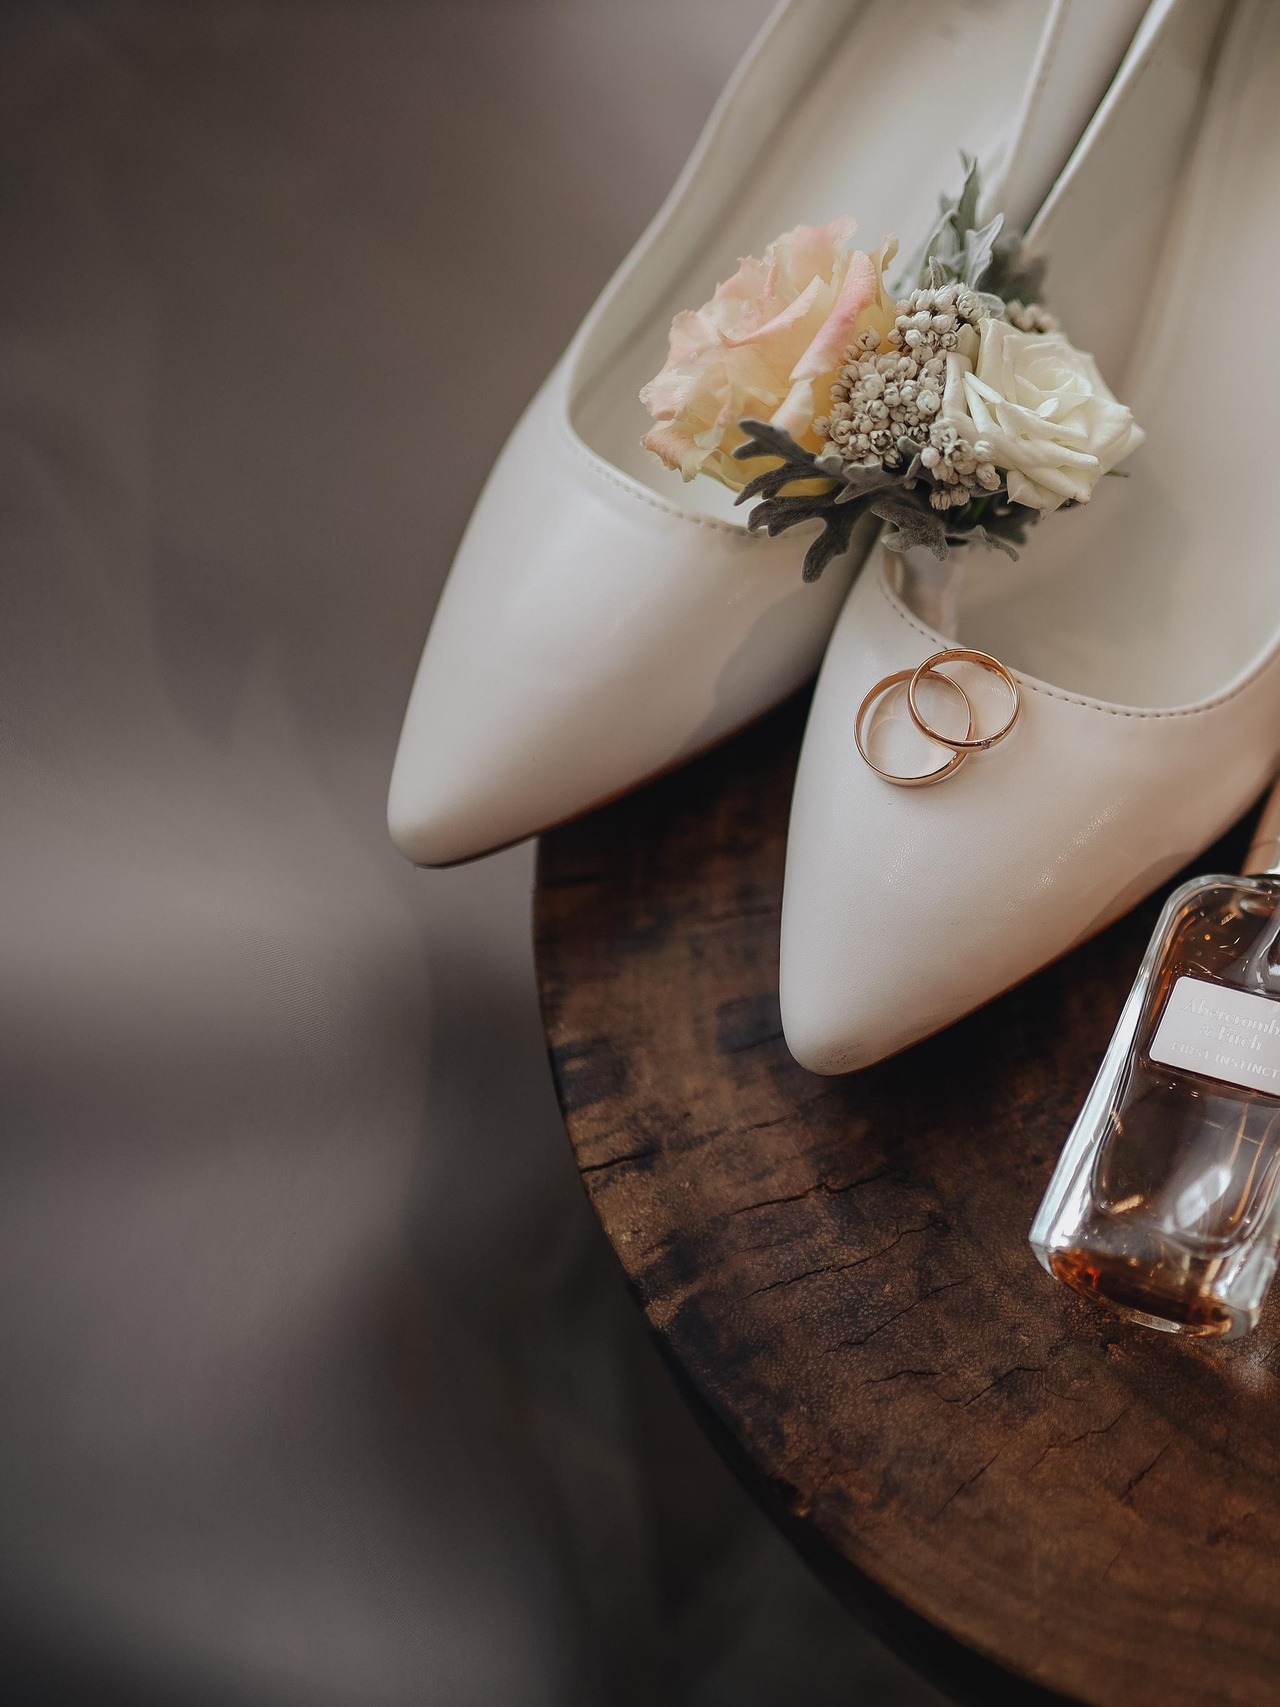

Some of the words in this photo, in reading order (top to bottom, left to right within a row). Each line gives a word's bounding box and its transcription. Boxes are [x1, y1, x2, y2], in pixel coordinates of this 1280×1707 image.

[1198, 1024, 1213, 1039] &
[1216, 1024, 1263, 1051] Fitch
[1170, 1040, 1210, 1061] FIRST
[1215, 1053, 1280, 1079] INSTINCT
